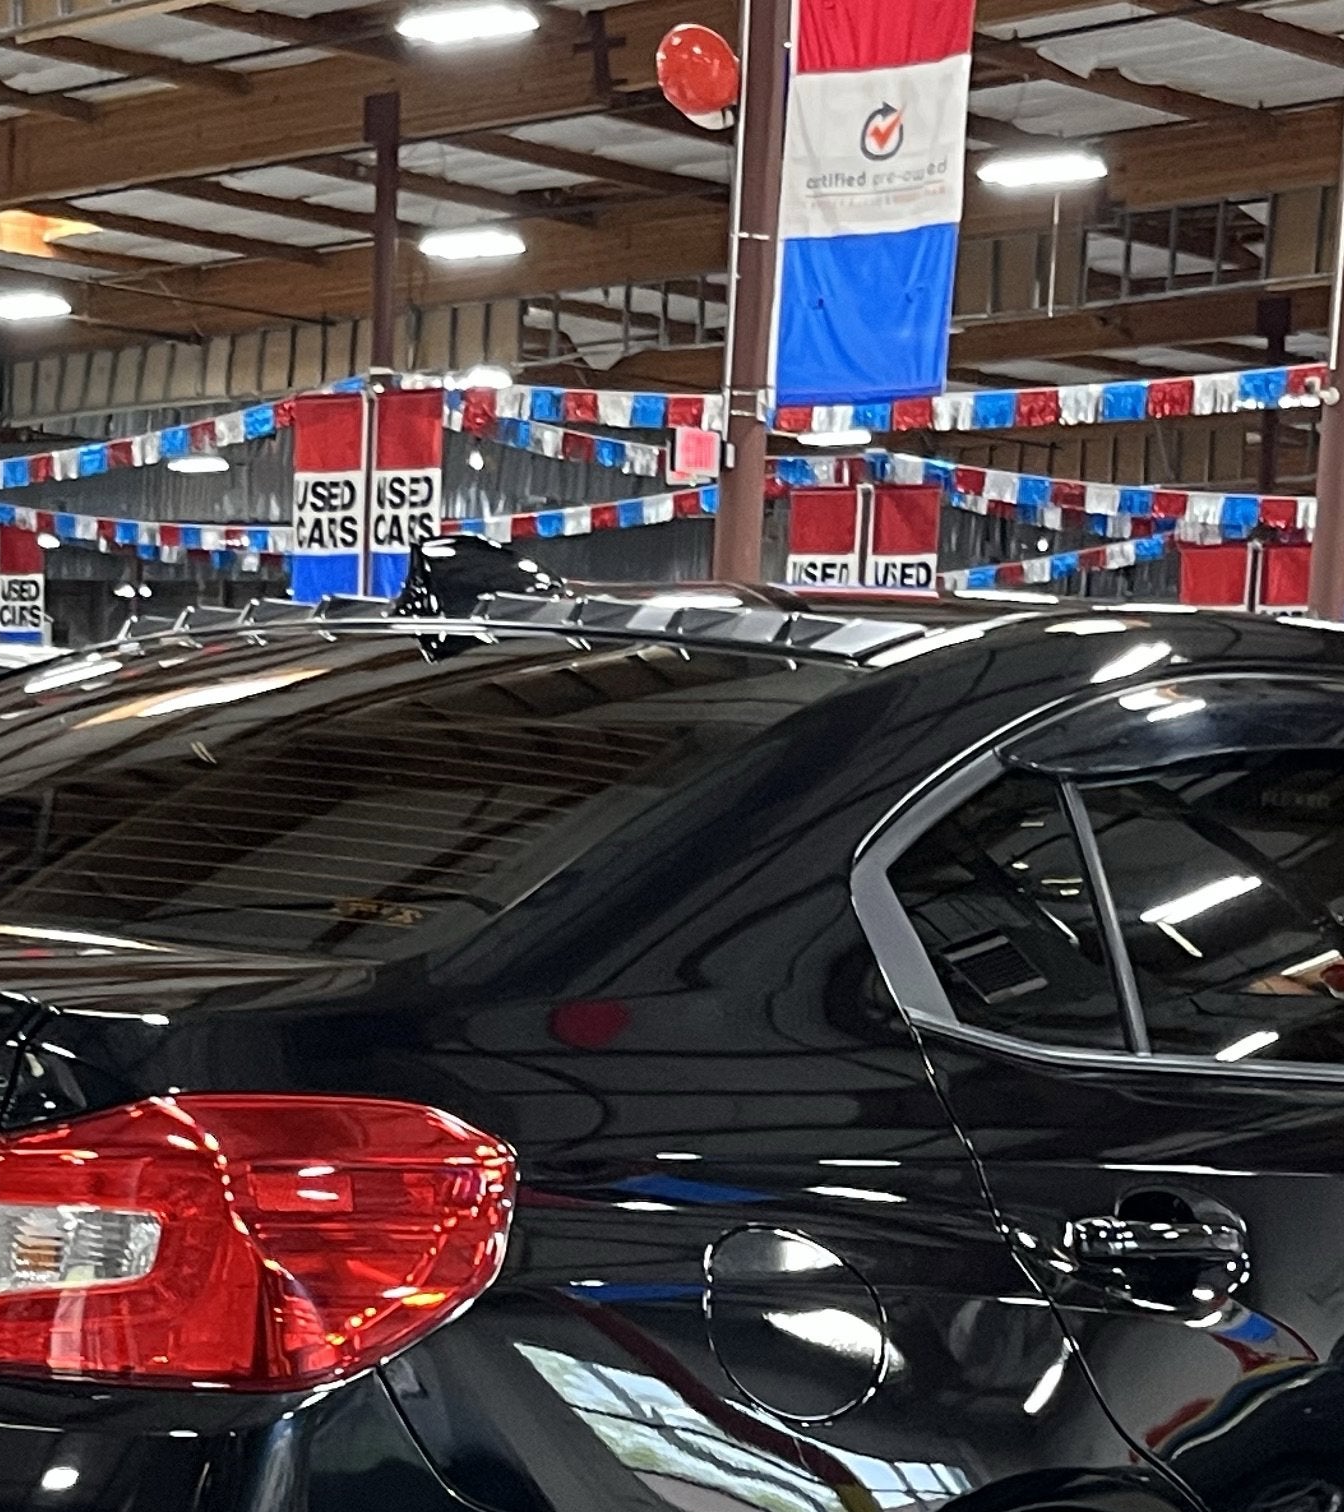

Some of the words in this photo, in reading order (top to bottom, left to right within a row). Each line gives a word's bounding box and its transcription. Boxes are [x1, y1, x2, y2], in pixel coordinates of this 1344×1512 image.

[296, 480, 356, 512] USED
[377, 476, 433, 509] USED
[296, 516, 358, 548] CARS
[374, 512, 434, 546] CARS
[875, 561, 932, 588] USED
